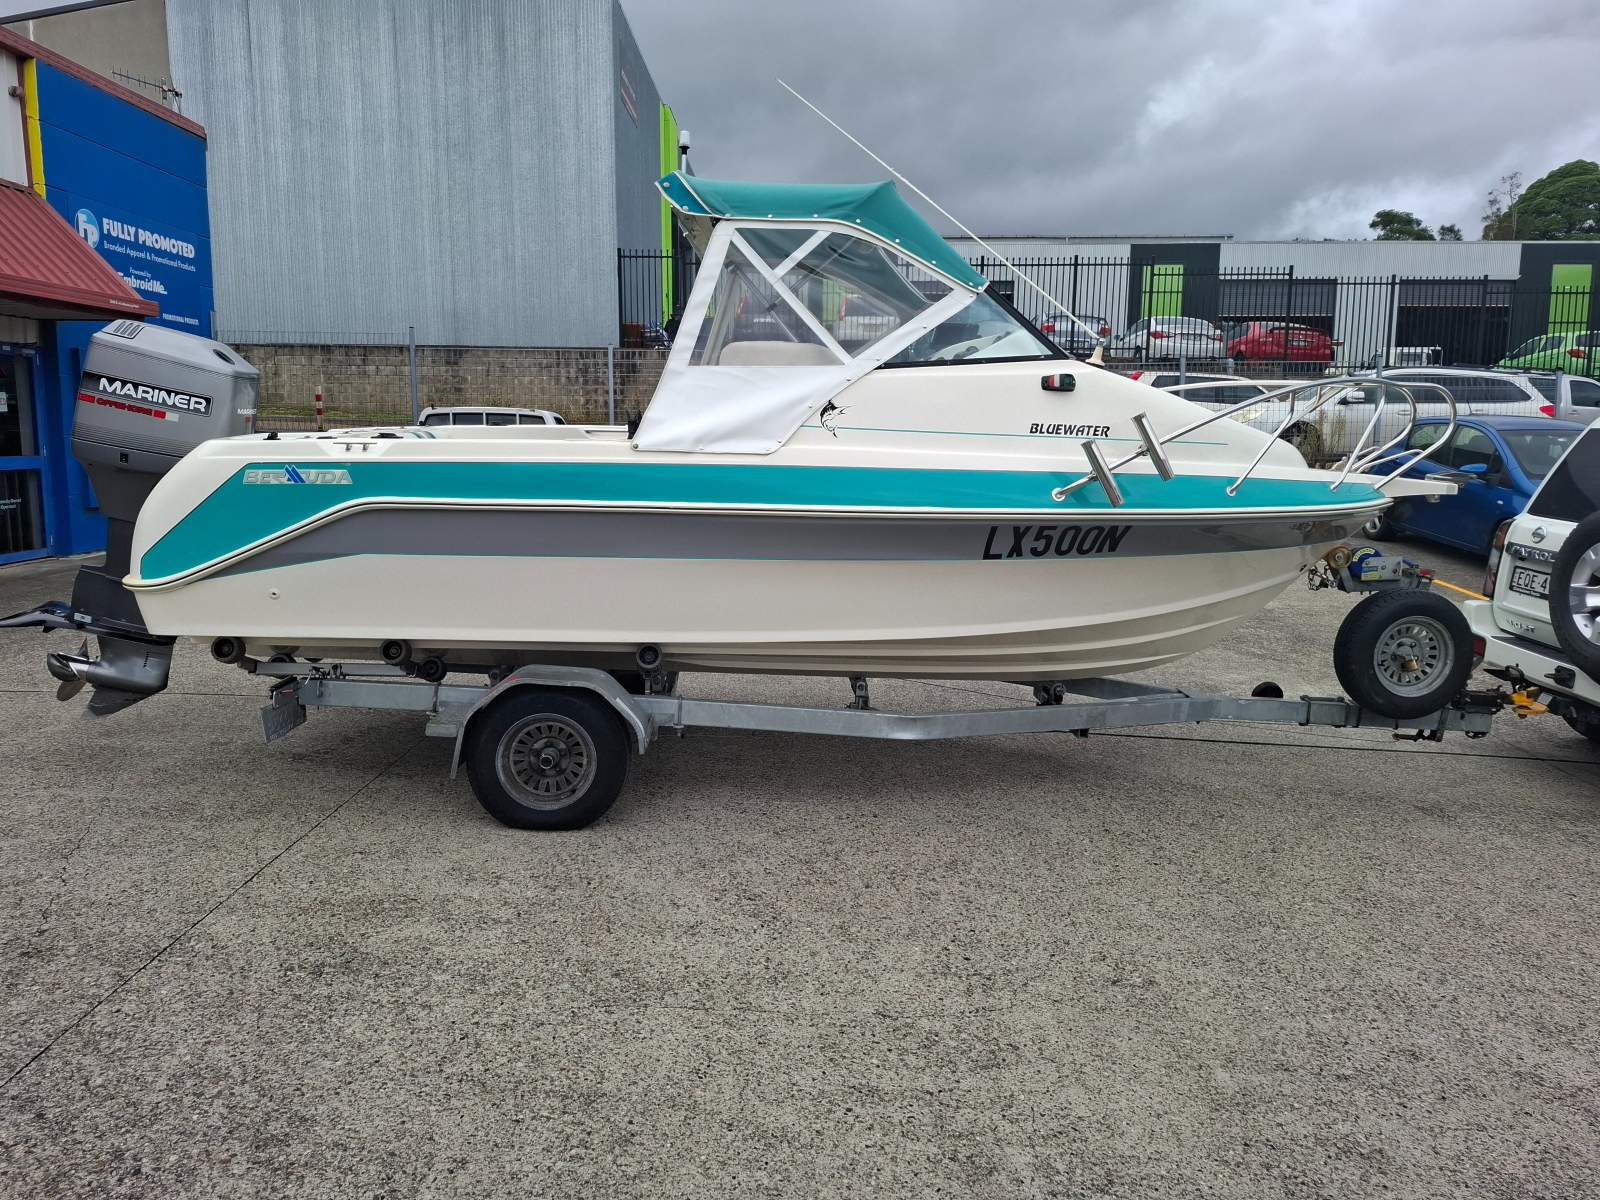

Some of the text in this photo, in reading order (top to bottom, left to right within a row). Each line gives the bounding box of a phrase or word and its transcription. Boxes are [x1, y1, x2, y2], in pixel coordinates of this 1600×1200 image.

[103, 217, 195, 258] FULLY PROMOTED
[103, 240, 126, 254] Branded
[127, 247, 146, 259] Apparel
[152, 253, 177, 267] Promotional
[178, 262, 196, 272] Products
[130, 267, 146, 277] Powered
[99, 377, 207, 413] MARINER
[1029, 423, 1111, 438] BLUEWATER
[983, 525, 1133, 560] LX500N
